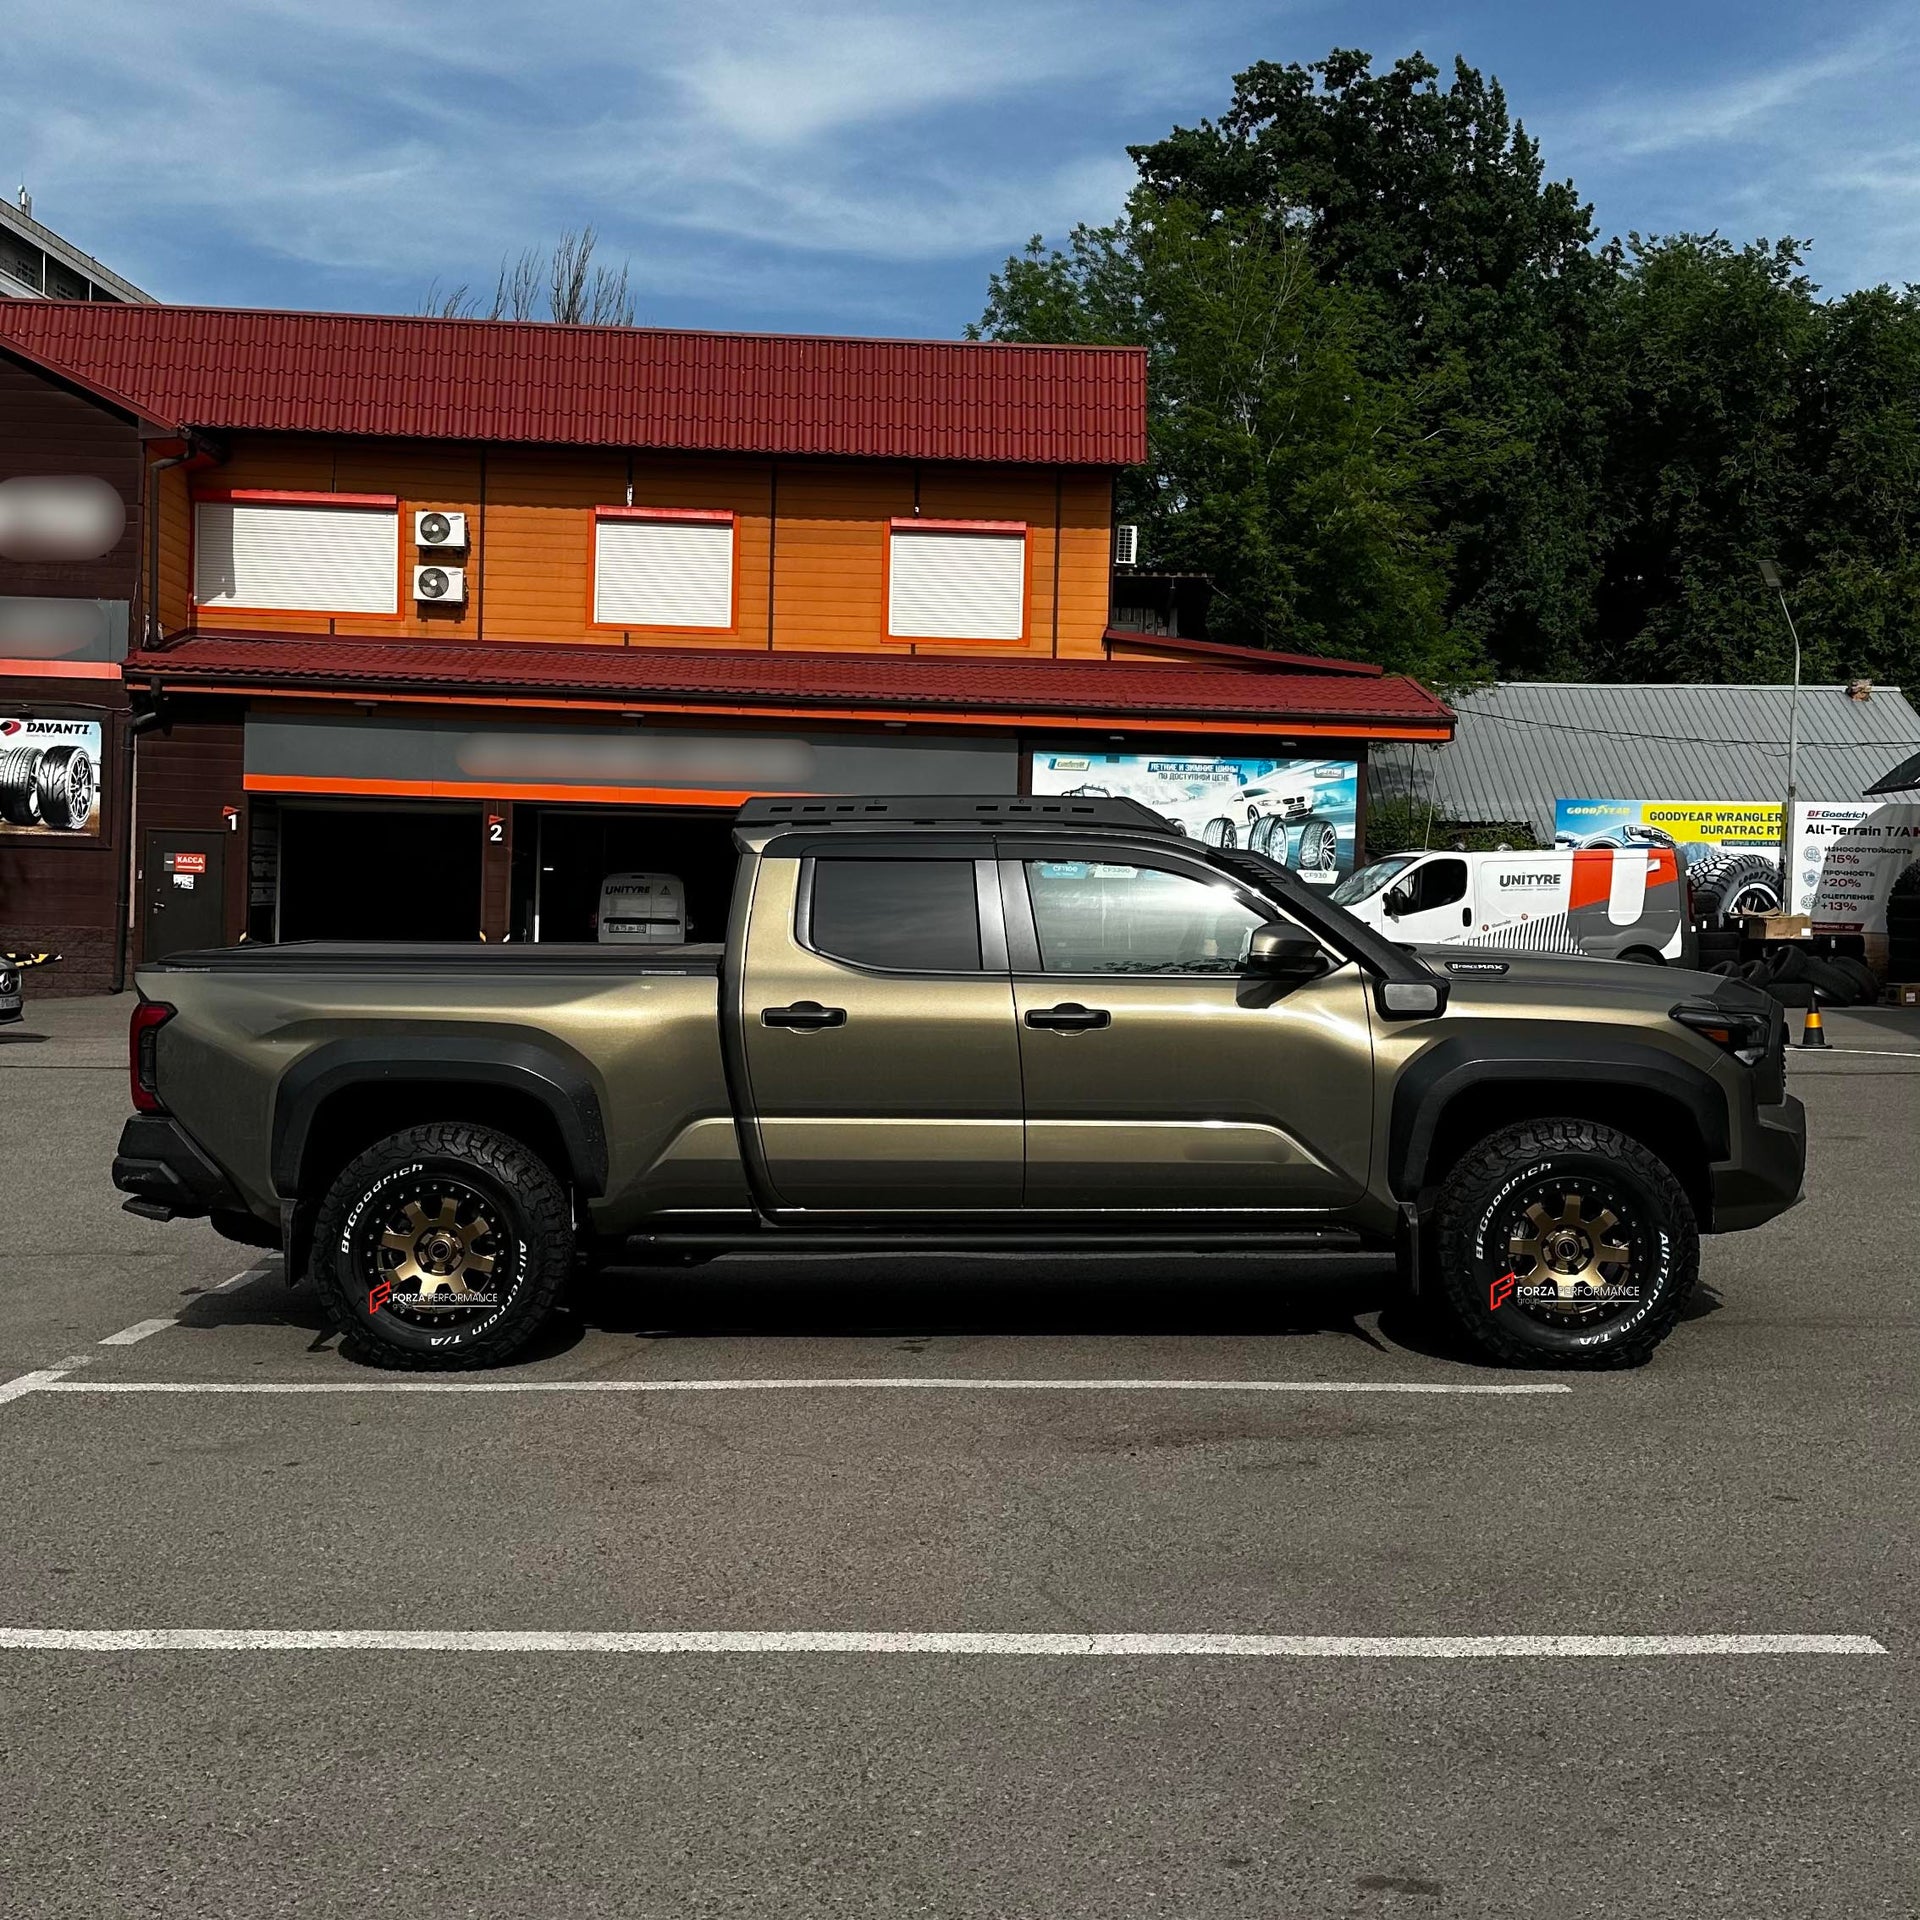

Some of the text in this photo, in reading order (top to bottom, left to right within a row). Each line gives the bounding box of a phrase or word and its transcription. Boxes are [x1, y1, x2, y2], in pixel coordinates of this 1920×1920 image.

[26, 722, 90, 735] DAVANTI
[1649, 811, 1783, 822] GOODYEAR WRANGLER
[1807, 810, 1868, 819] BFGoodrich
[228, 814, 237, 831] 1
[490, 824, 503, 841] 2
[1700, 825, 1782, 835] DURATRAC RT
[1805, 825, 1881, 836] All-Terrain
[1886, 827, 1911, 837] T/A
[177, 856, 204, 864] КАССА
[1825, 854, 1860, 864] +15%
[1499, 872, 1561, 887] UNITYRE
[1823, 879, 1861, 888] +20%
[605, 886, 651, 895] UNITYRE
[1821, 902, 1857, 911] +13%
[341, 1163, 423, 1254] BFGoodrich
[1475, 1162, 1551, 1259] BFGoodrich
[1619, 1230, 1671, 1333] All-Terrain
[472, 1240, 527, 1336] All-Terrain
